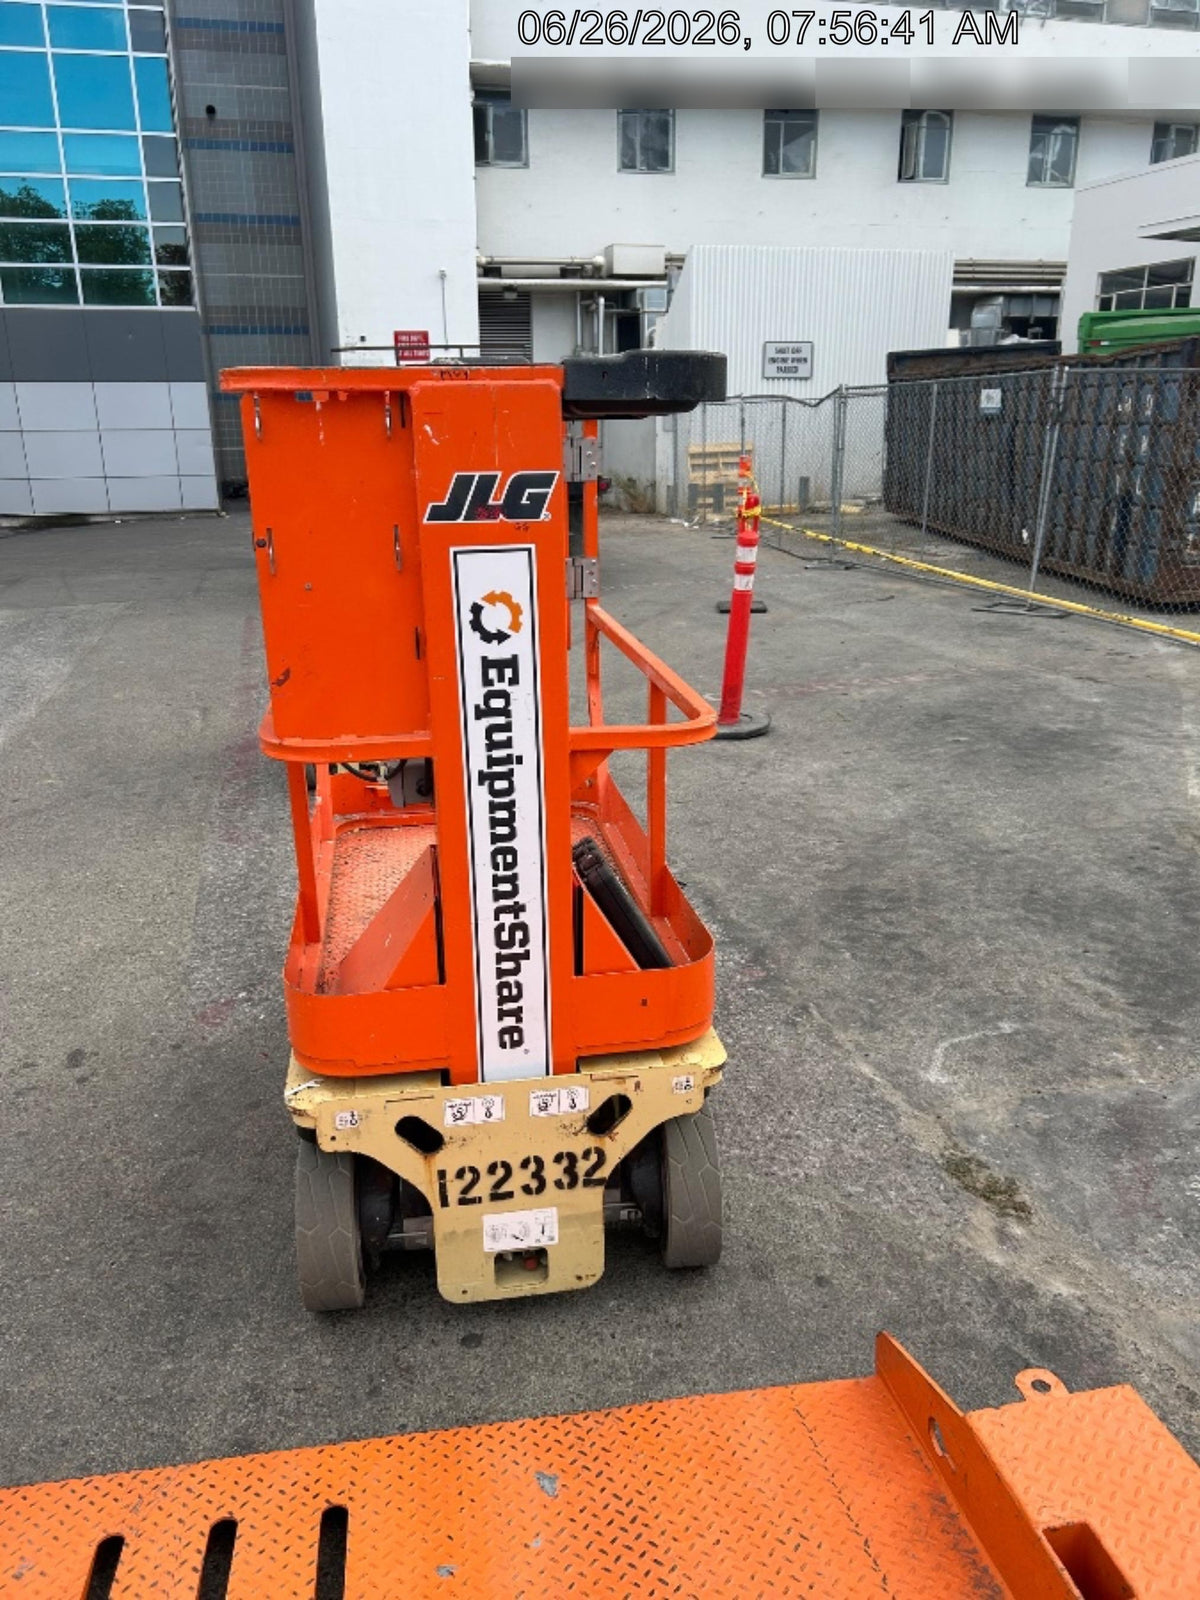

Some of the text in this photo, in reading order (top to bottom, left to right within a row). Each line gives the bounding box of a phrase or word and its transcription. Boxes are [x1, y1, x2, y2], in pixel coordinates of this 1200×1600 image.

[423, 471, 559, 524] JLG
[474, 654, 530, 1050] EquipmentShare
[437, 1146, 607, 1208] 122332
